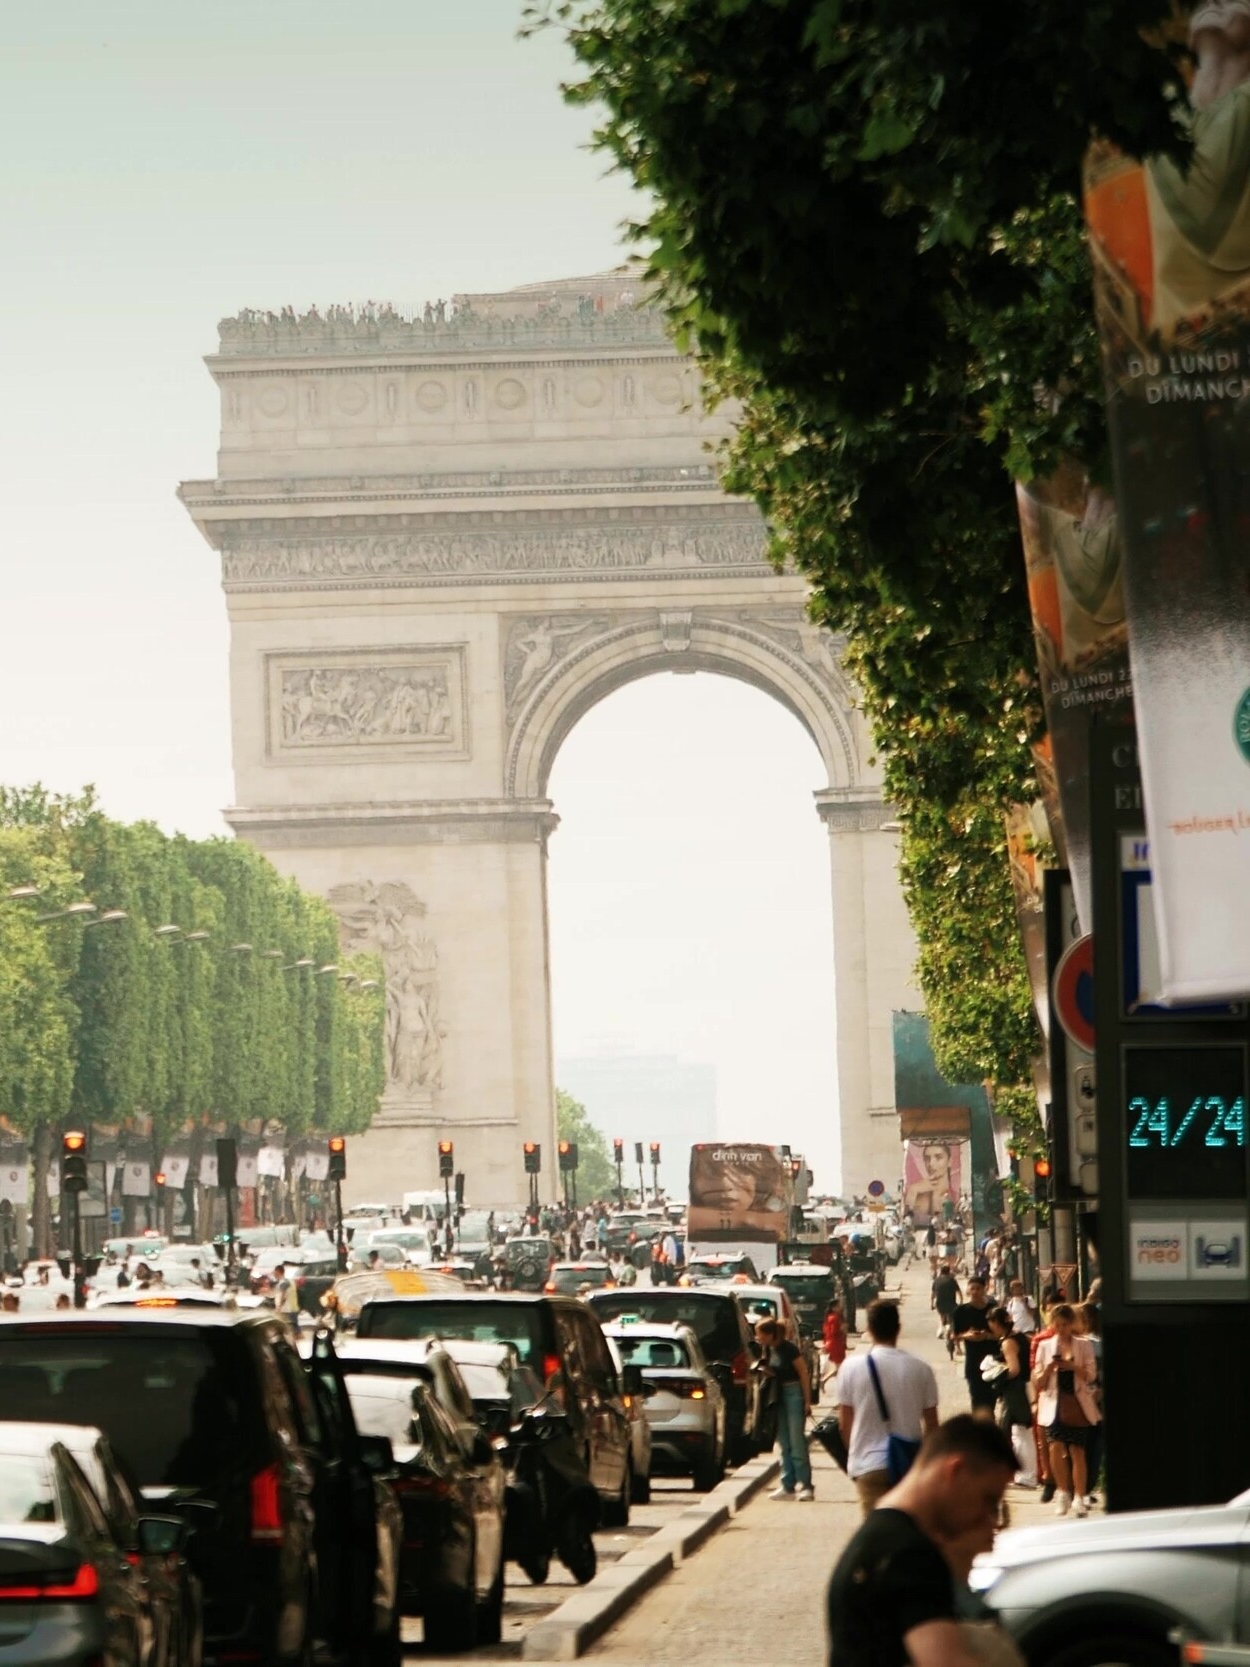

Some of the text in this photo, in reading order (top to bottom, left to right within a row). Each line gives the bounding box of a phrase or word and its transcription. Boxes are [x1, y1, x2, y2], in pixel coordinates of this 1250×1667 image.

[1129, 353, 1239, 378] DU LUNDI
[1050, 681, 1069, 694] DU
[1072, 671, 1113, 689] LUNDI
[1129, 1096, 1244, 1147] 24/24
[740, 1153, 762, 1162] van
[1137, 1250, 1181, 1264] neo
